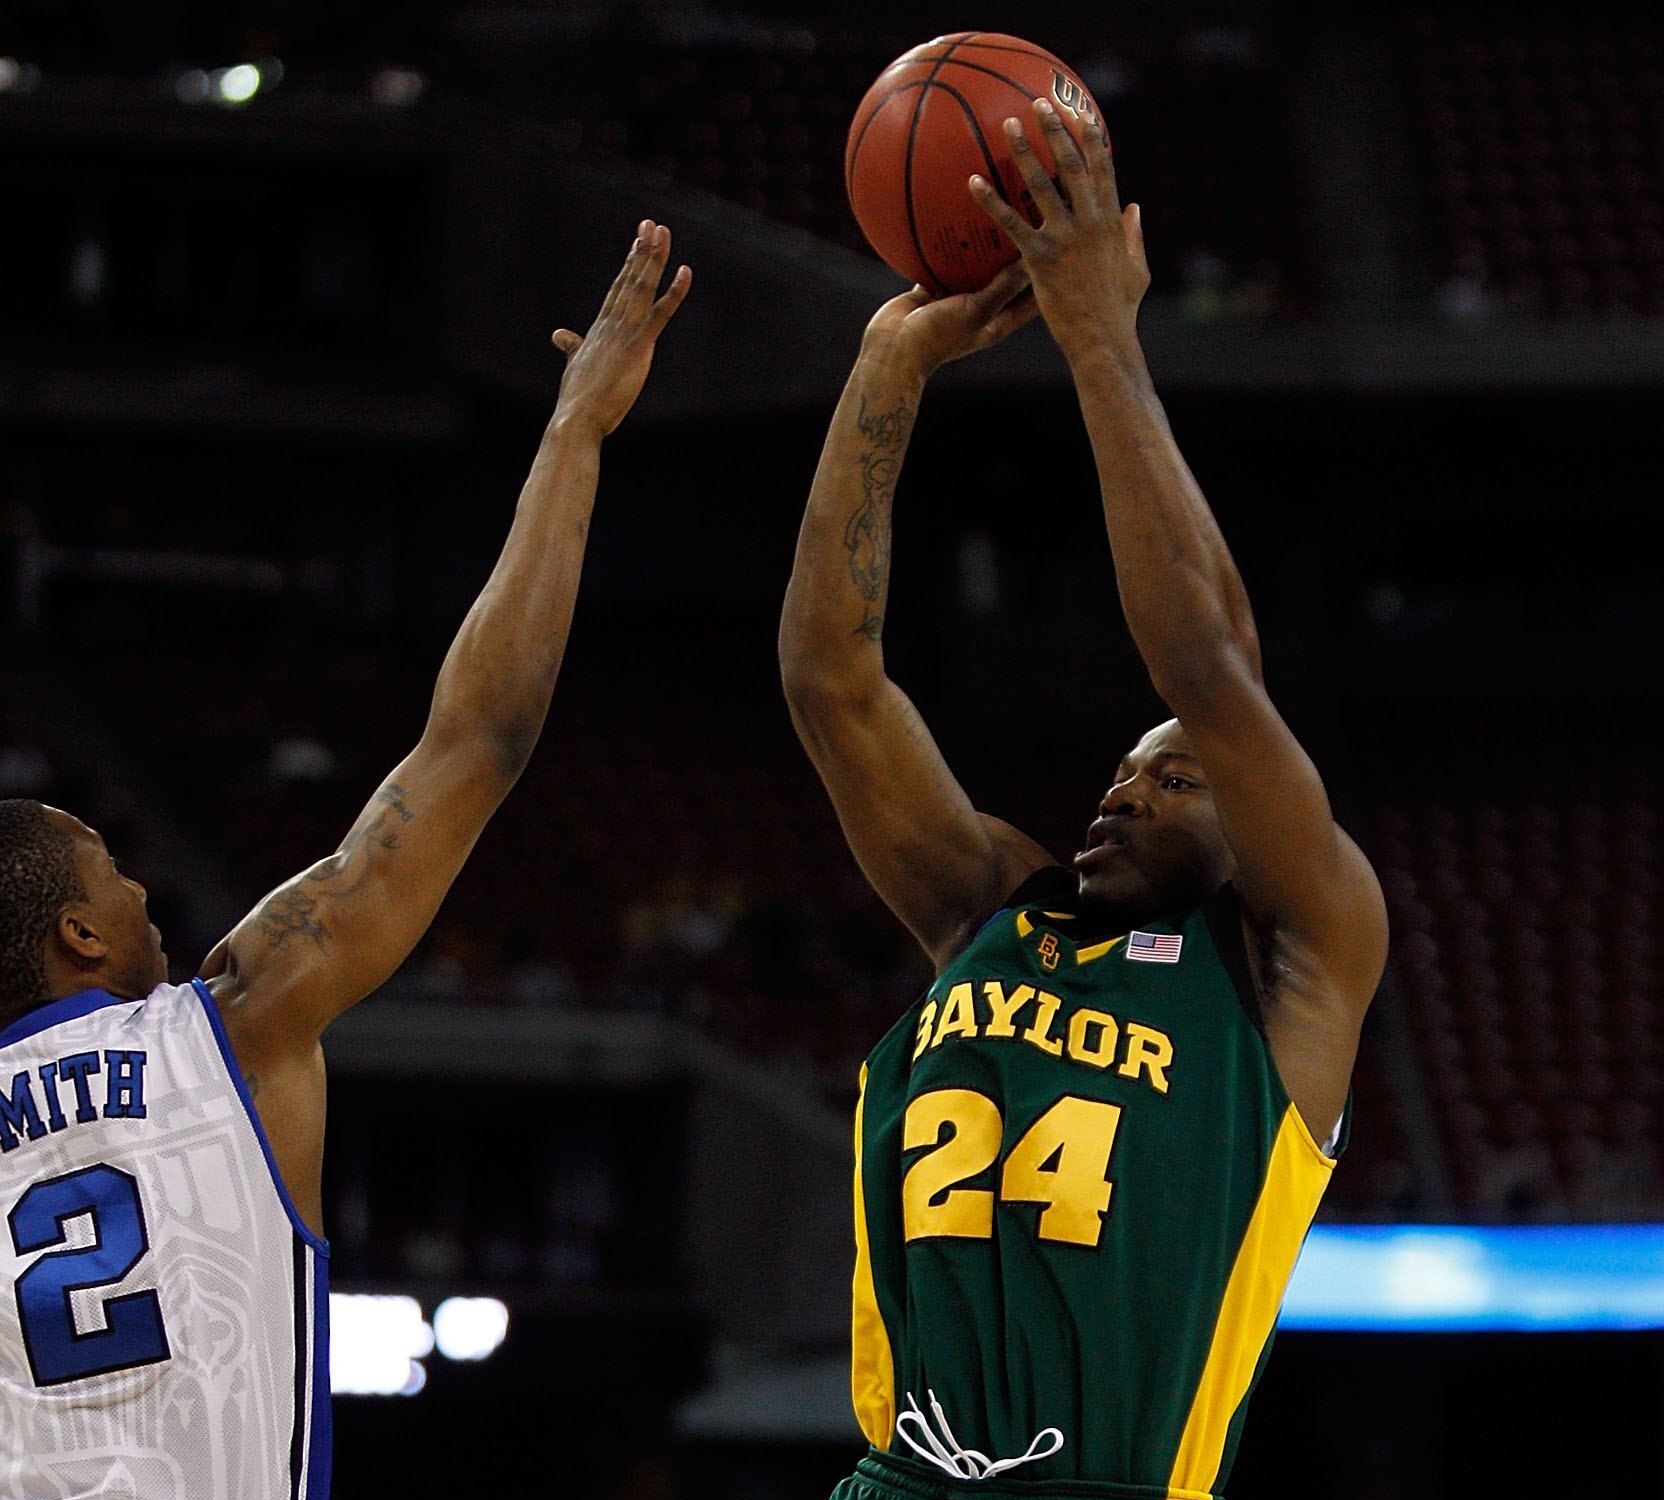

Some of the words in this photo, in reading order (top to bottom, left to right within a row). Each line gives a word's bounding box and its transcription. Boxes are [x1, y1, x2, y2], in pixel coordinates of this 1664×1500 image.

[911, 979, 1175, 1095] BAYLOR
[902, 1087, 1122, 1248] 24
[7, 1161, 172, 1388] 2
